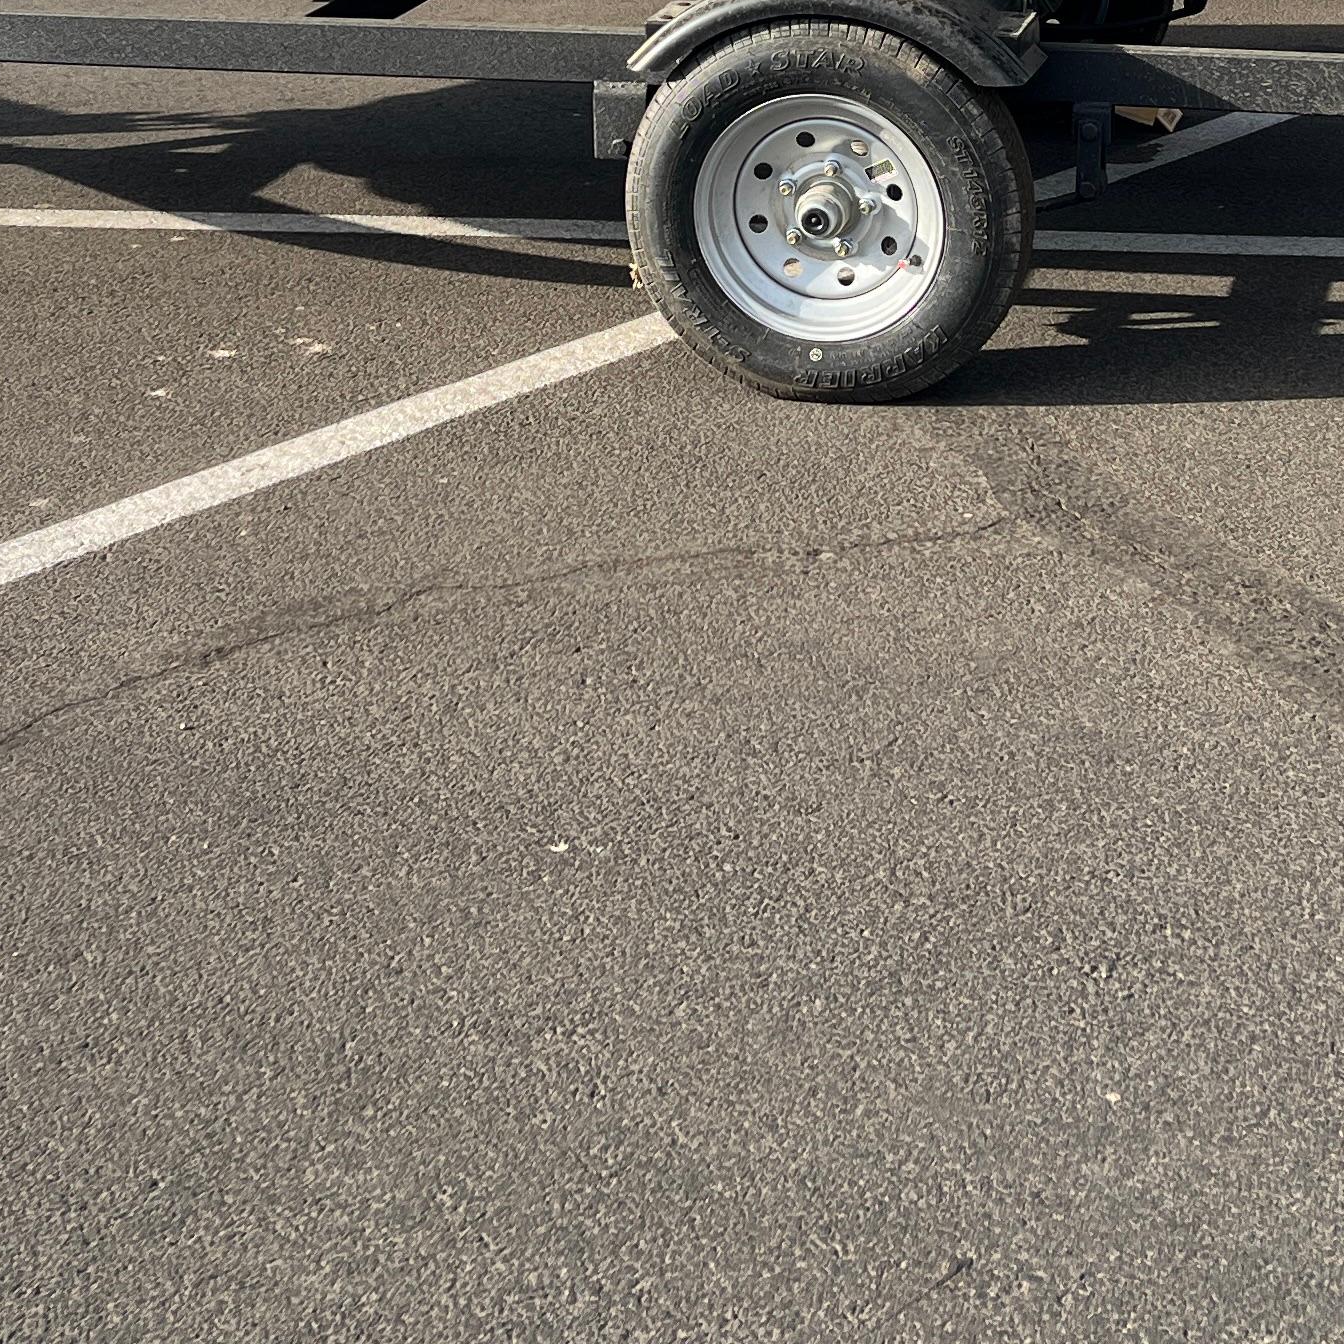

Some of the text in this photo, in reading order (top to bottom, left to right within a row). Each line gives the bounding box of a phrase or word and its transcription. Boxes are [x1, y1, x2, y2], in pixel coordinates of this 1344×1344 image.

[669, 69, 740, 140] LOAD
[770, 48, 867, 77] STAR
[792, 324, 949, 388] KARRIER
